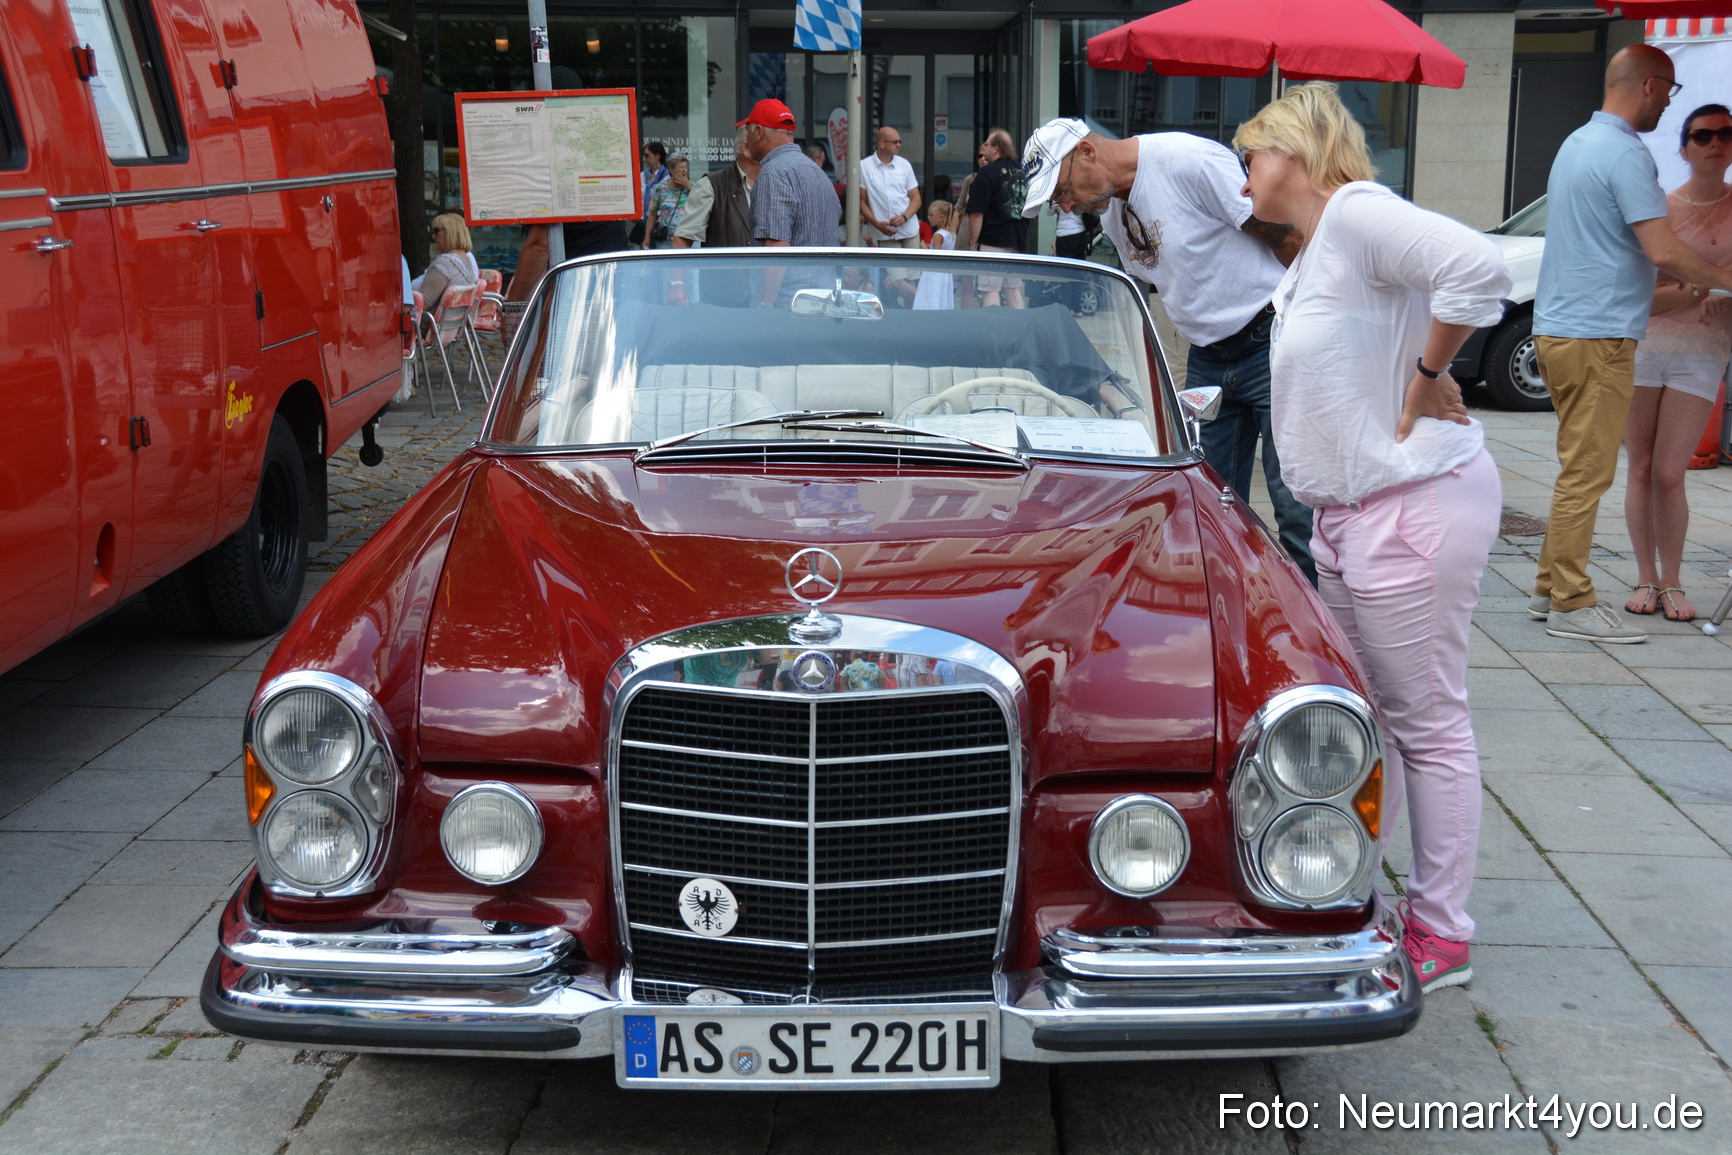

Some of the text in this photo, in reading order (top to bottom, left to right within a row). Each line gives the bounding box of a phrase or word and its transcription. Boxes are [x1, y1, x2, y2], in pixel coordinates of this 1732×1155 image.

[1482, 63, 1499, 75] 22
[662, 137, 684, 147] SIND
[706, 137, 720, 147] SIE
[660, 1019, 987, 1074] AS SE 220H
[634, 1053, 647, 1069] D
